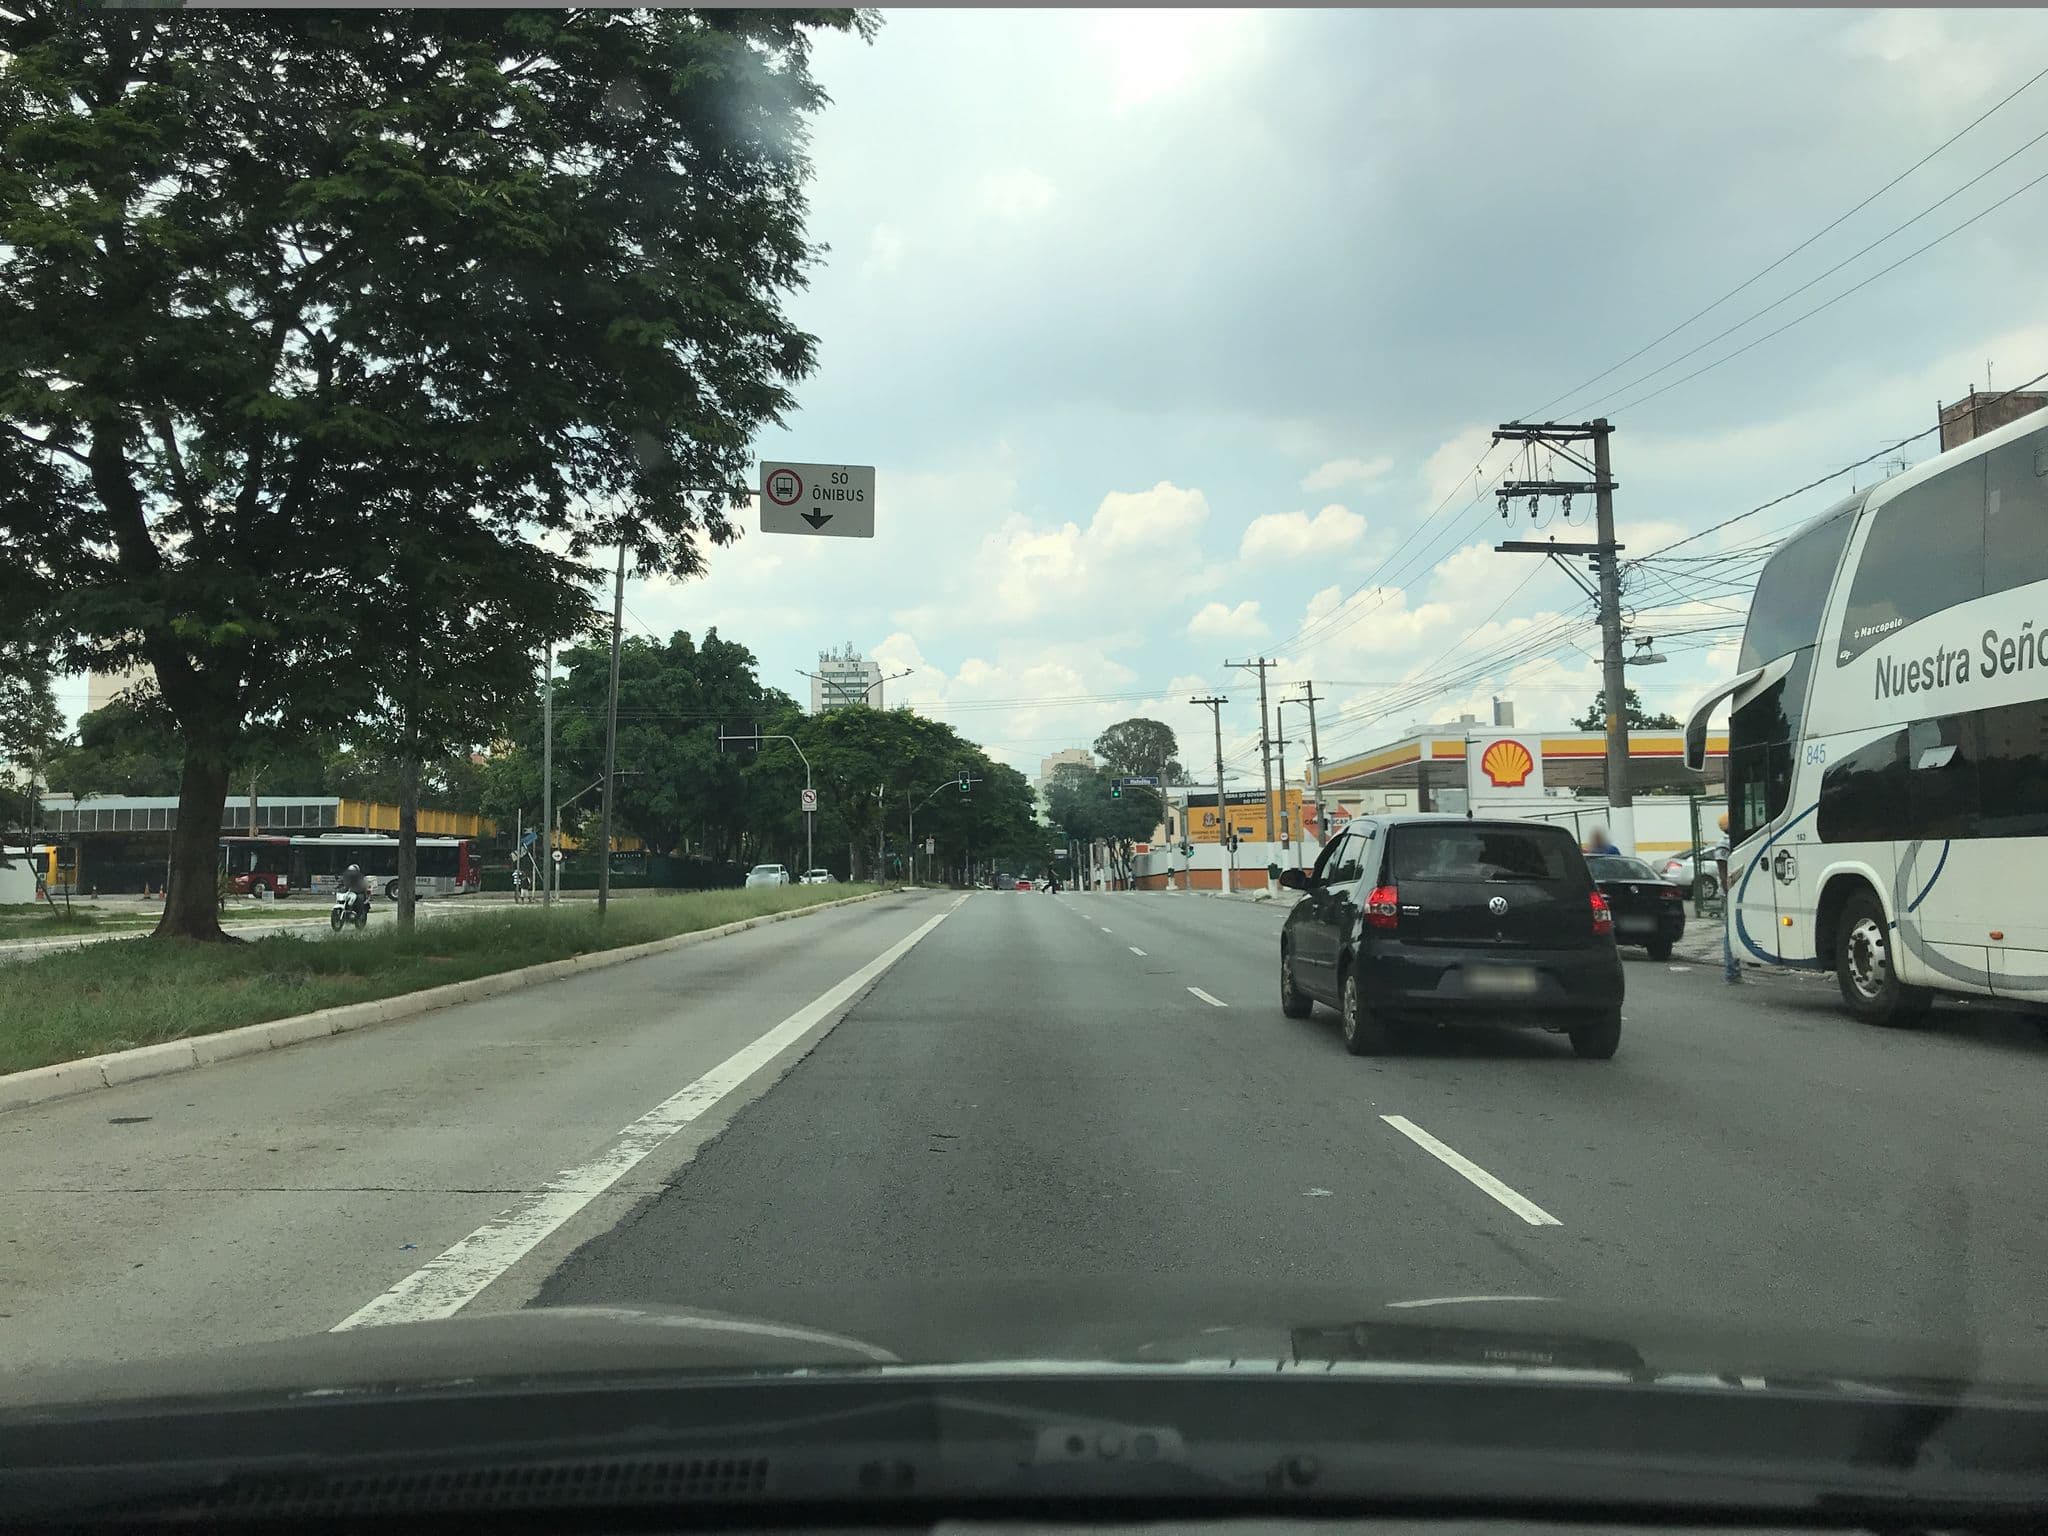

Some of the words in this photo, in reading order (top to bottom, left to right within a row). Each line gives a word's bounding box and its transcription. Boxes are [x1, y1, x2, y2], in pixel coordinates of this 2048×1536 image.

[812, 485, 865, 502] ÔNIBUS
[1861, 617, 1903, 637] Marcopolo
[1875, 643, 1970, 700] Nuestra
[1980, 620, 2048, 678] Seño
[1806, 744, 1826, 765] 845
